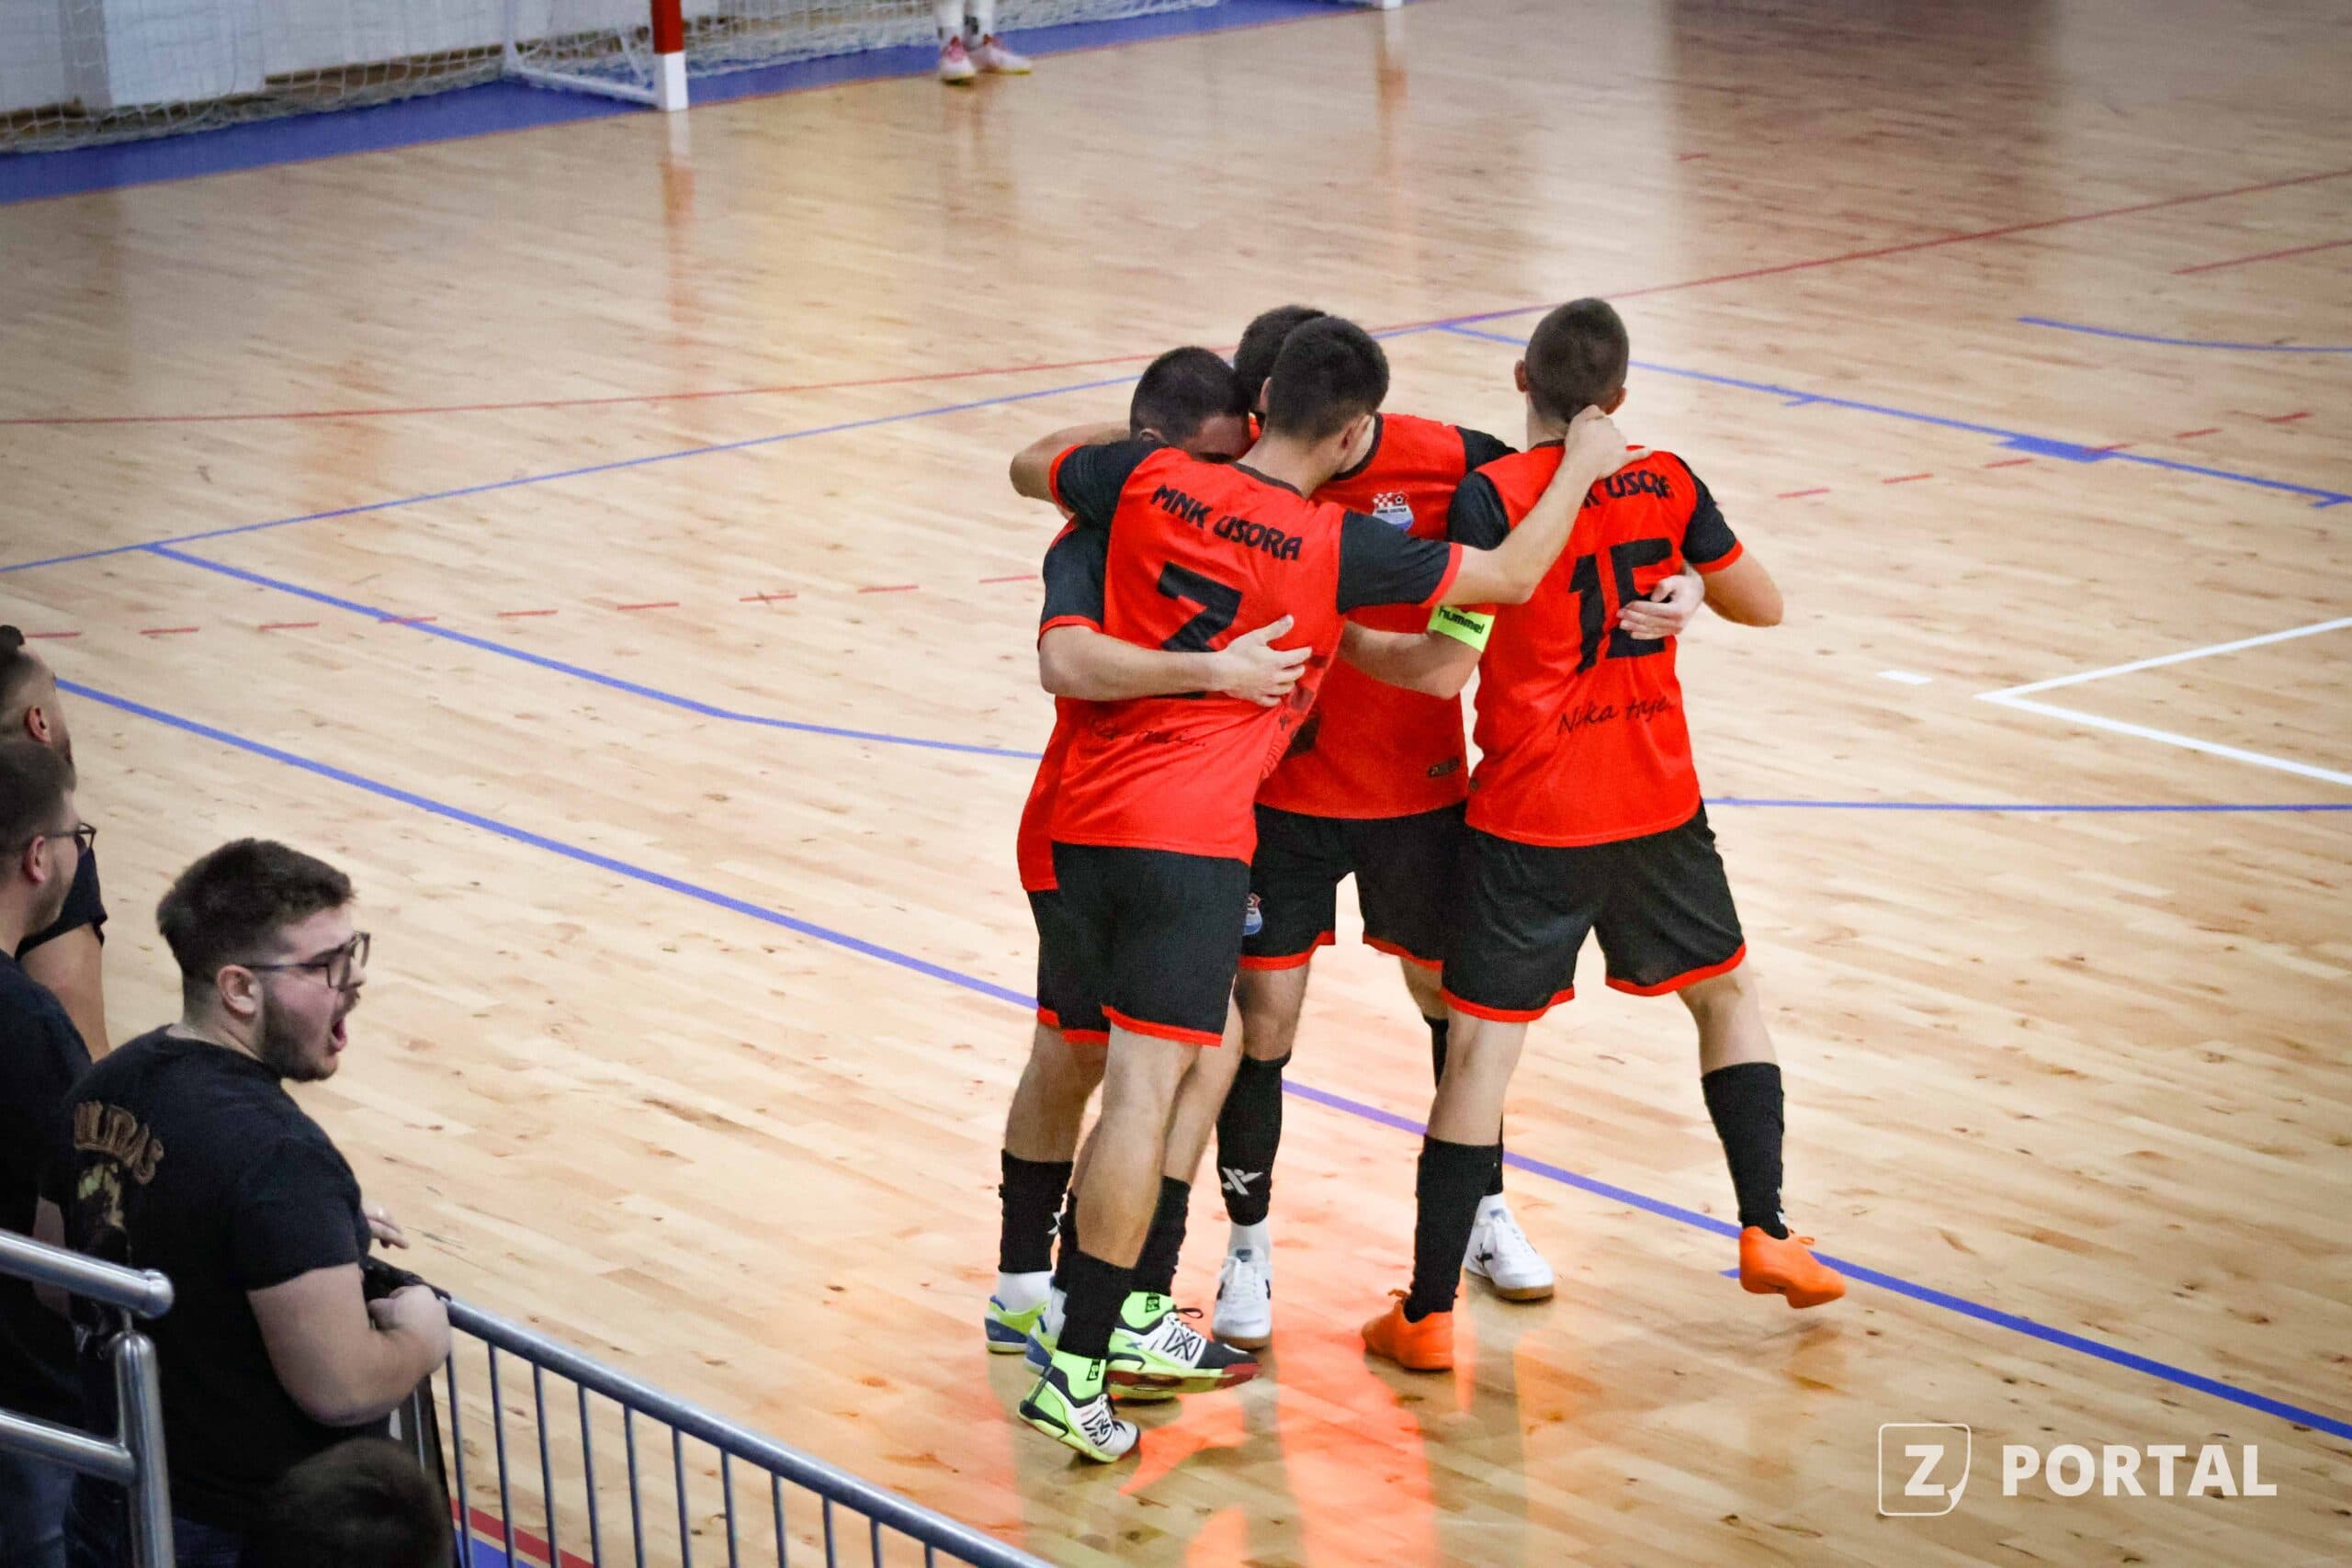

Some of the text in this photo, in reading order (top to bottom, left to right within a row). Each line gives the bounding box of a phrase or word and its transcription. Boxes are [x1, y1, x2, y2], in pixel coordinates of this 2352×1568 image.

[1150, 484, 1303, 561] MNK USORA
[1438, 605, 1486, 634] hummel
[1569, 537, 1672, 673] 15
